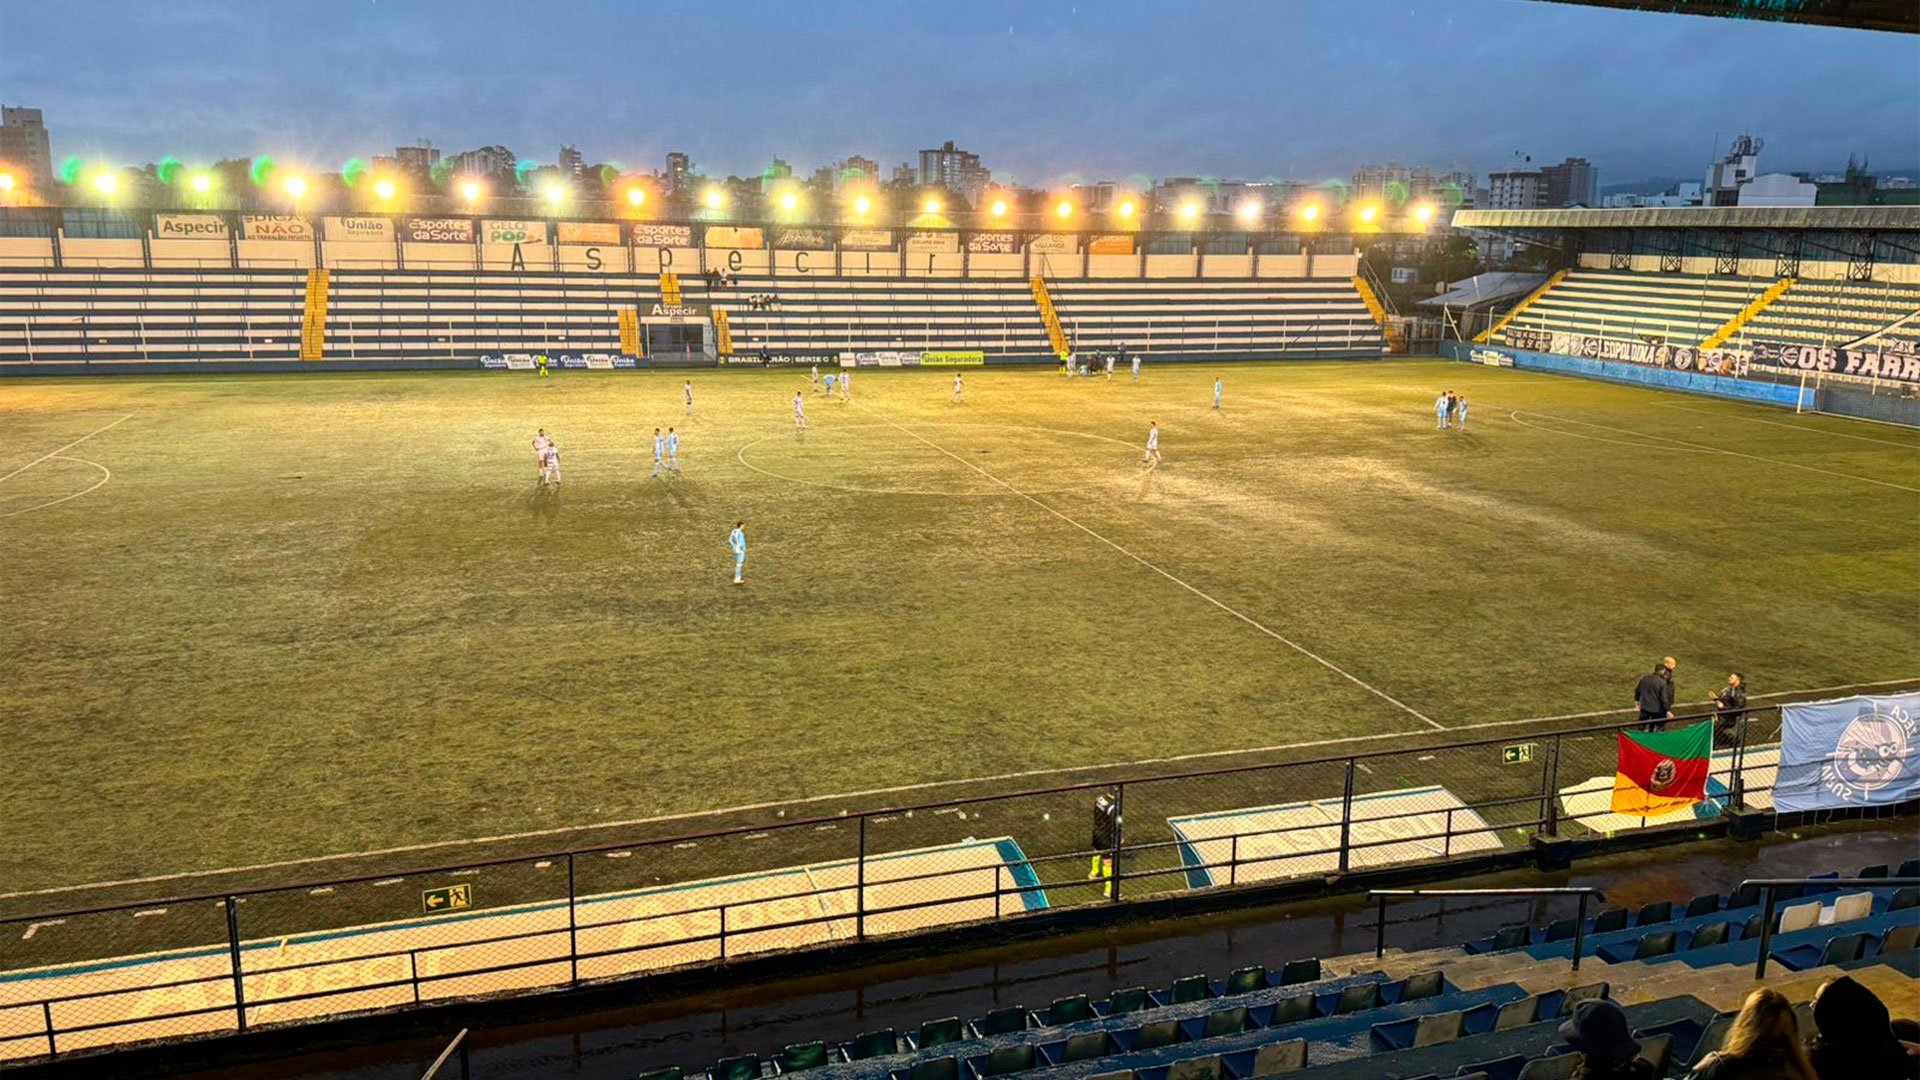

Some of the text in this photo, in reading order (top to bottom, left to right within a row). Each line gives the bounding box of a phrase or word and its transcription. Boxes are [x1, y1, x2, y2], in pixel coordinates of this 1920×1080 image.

[163, 220, 225, 235] Aspecir
[255, 222, 304, 234] NÃO
[346, 218, 383, 230] União
[409, 218, 471, 231] Esportes
[633, 223, 690, 236] Esportes
[491, 230, 526, 243] POP
[652, 303, 697, 316] Aspecir
[1798, 346, 1837, 371] OS
